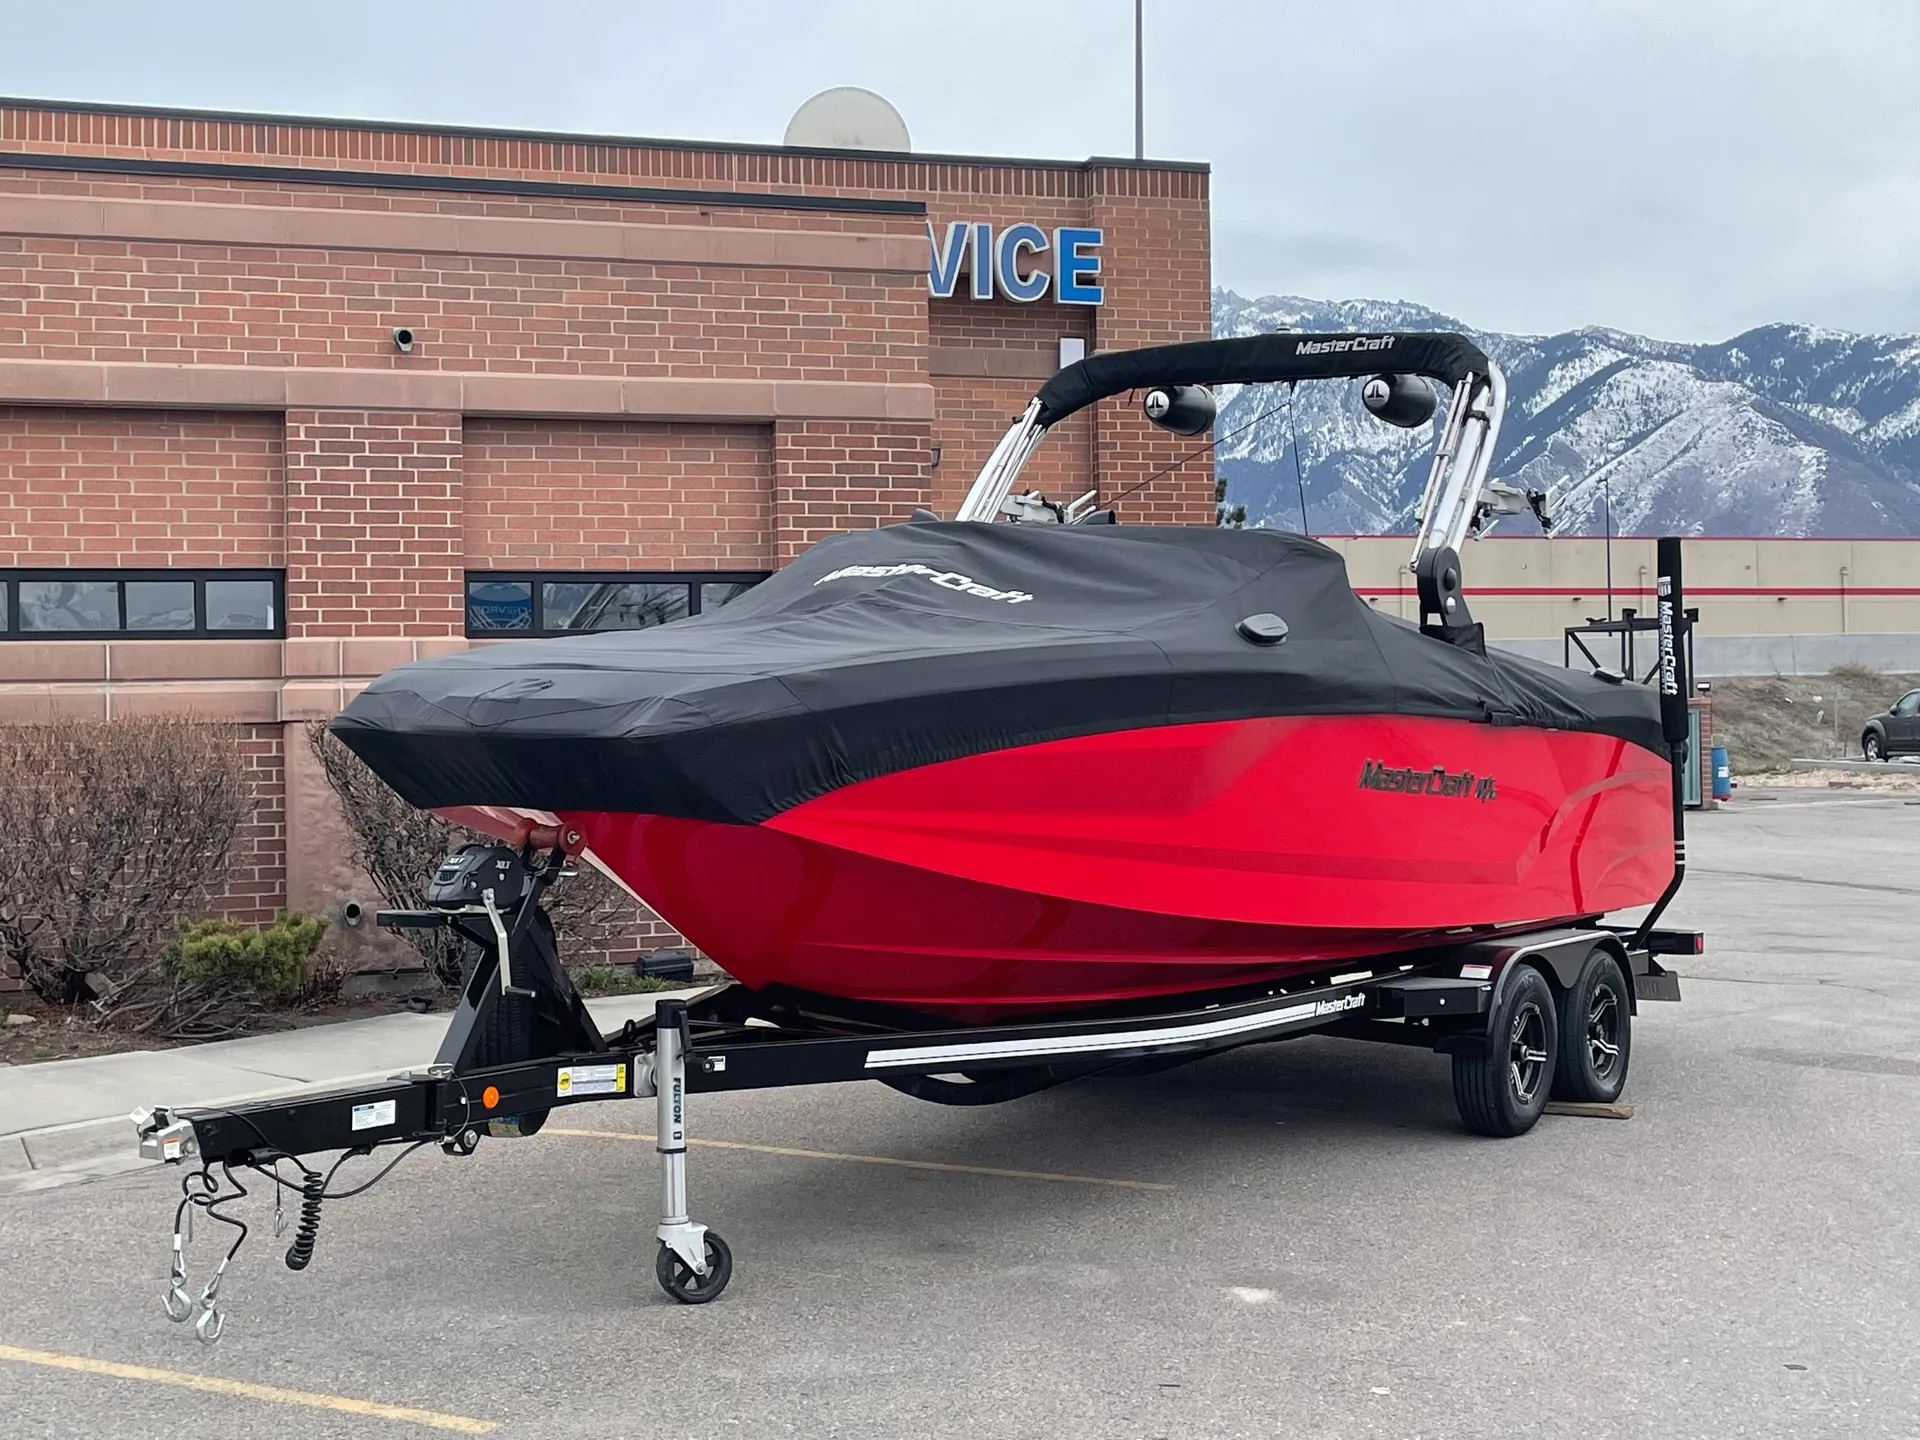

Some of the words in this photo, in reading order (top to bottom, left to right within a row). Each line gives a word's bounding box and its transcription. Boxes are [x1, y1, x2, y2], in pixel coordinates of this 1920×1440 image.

[1295, 335, 1395, 355] MasterCraft
[813, 563, 1034, 604] MasterCraft
[1661, 601, 1678, 695] MasterCraft
[1358, 758, 1475, 798] MasterCraft
[495, 860, 511, 869] XLT
[673, 1077, 681, 1124] FULTON
